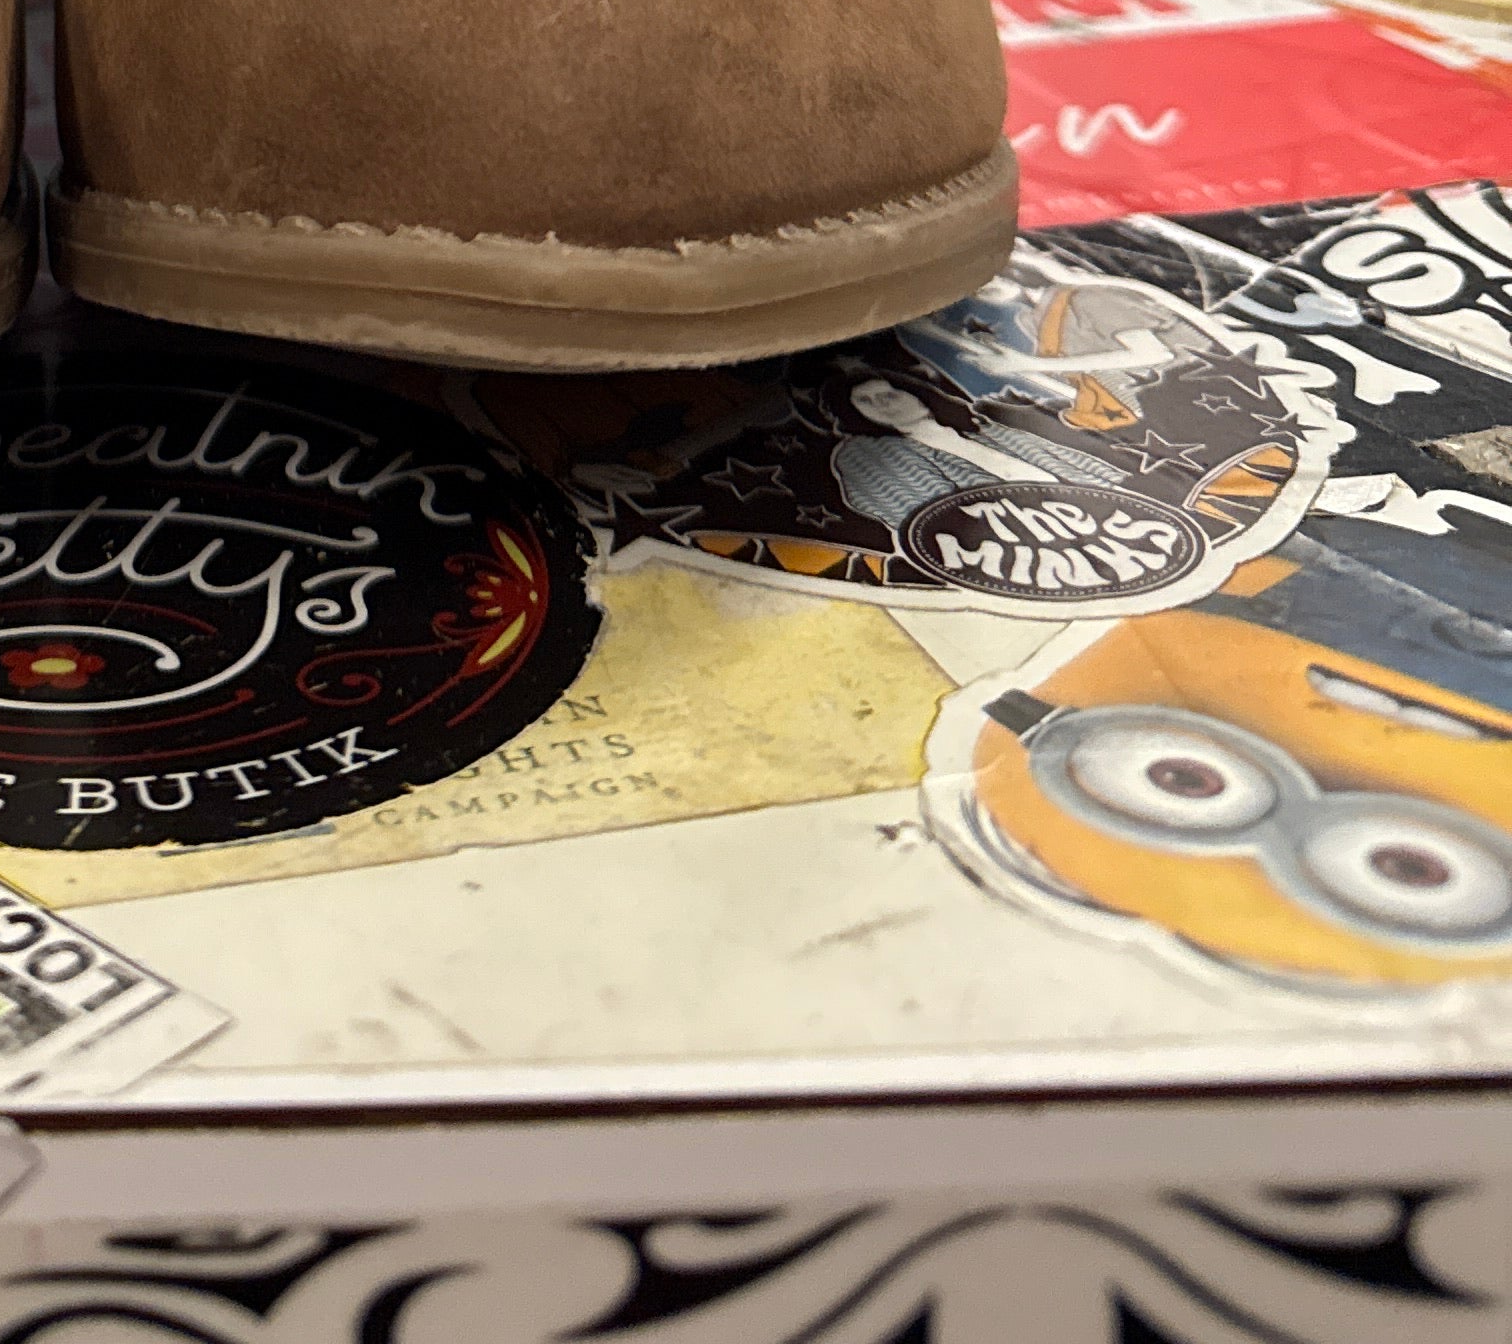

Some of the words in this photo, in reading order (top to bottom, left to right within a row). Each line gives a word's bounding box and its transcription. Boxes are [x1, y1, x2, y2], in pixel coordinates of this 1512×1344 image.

[935, 509, 1179, 590] MINKS
[959, 497, 1098, 543] The
[54, 725, 400, 815] BUTIK
